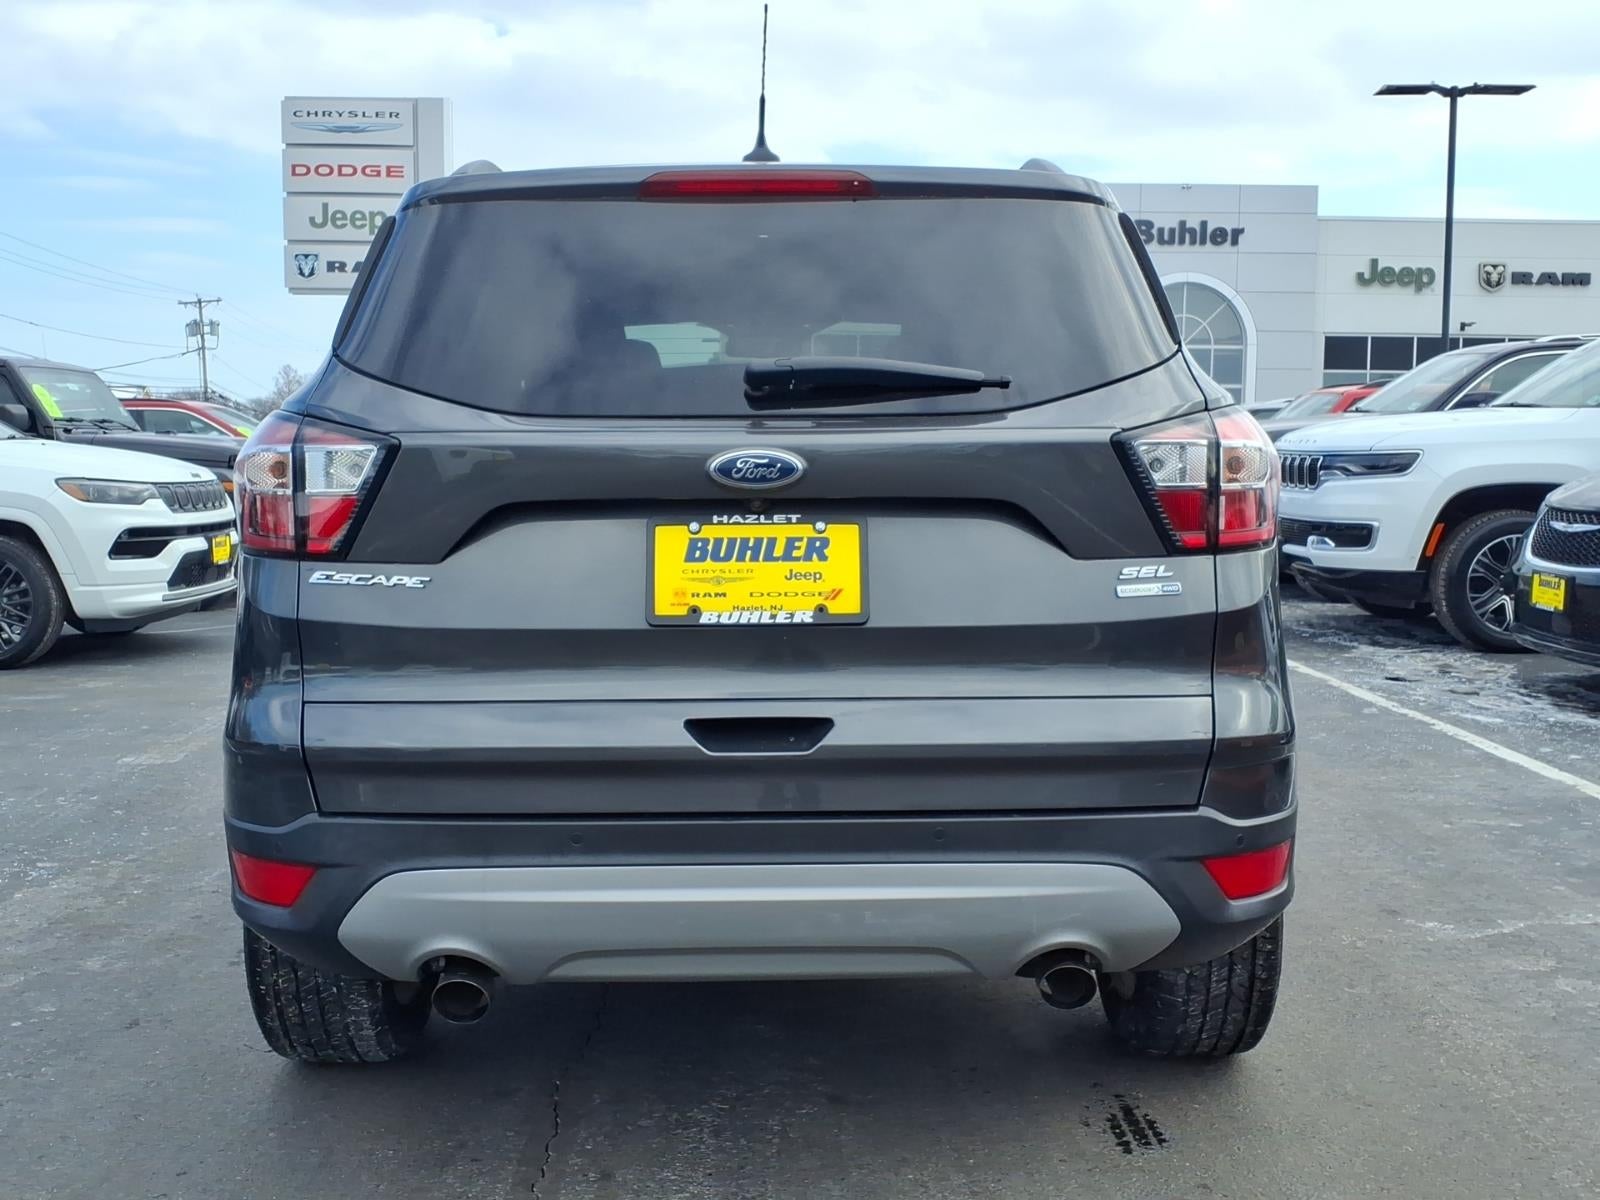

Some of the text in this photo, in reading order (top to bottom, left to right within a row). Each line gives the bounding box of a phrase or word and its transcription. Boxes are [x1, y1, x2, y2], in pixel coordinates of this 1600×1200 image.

[293, 110, 400, 119] CHRYSLER
[291, 164, 405, 178] DODGE
[308, 202, 387, 235] Jeep
[1134, 219, 1245, 246] Buhler
[1355, 258, 1436, 293] Jeep
[1511, 271, 1592, 286] RAM
[732, 457, 782, 479] Ford
[712, 514, 802, 524] HAZLET
[683, 536, 831, 563] BUHLER
[784, 569, 823, 583] Jeep
[1119, 565, 1174, 579] SEL
[690, 591, 727, 599] RAM
[699, 610, 814, 624] BUHLER
